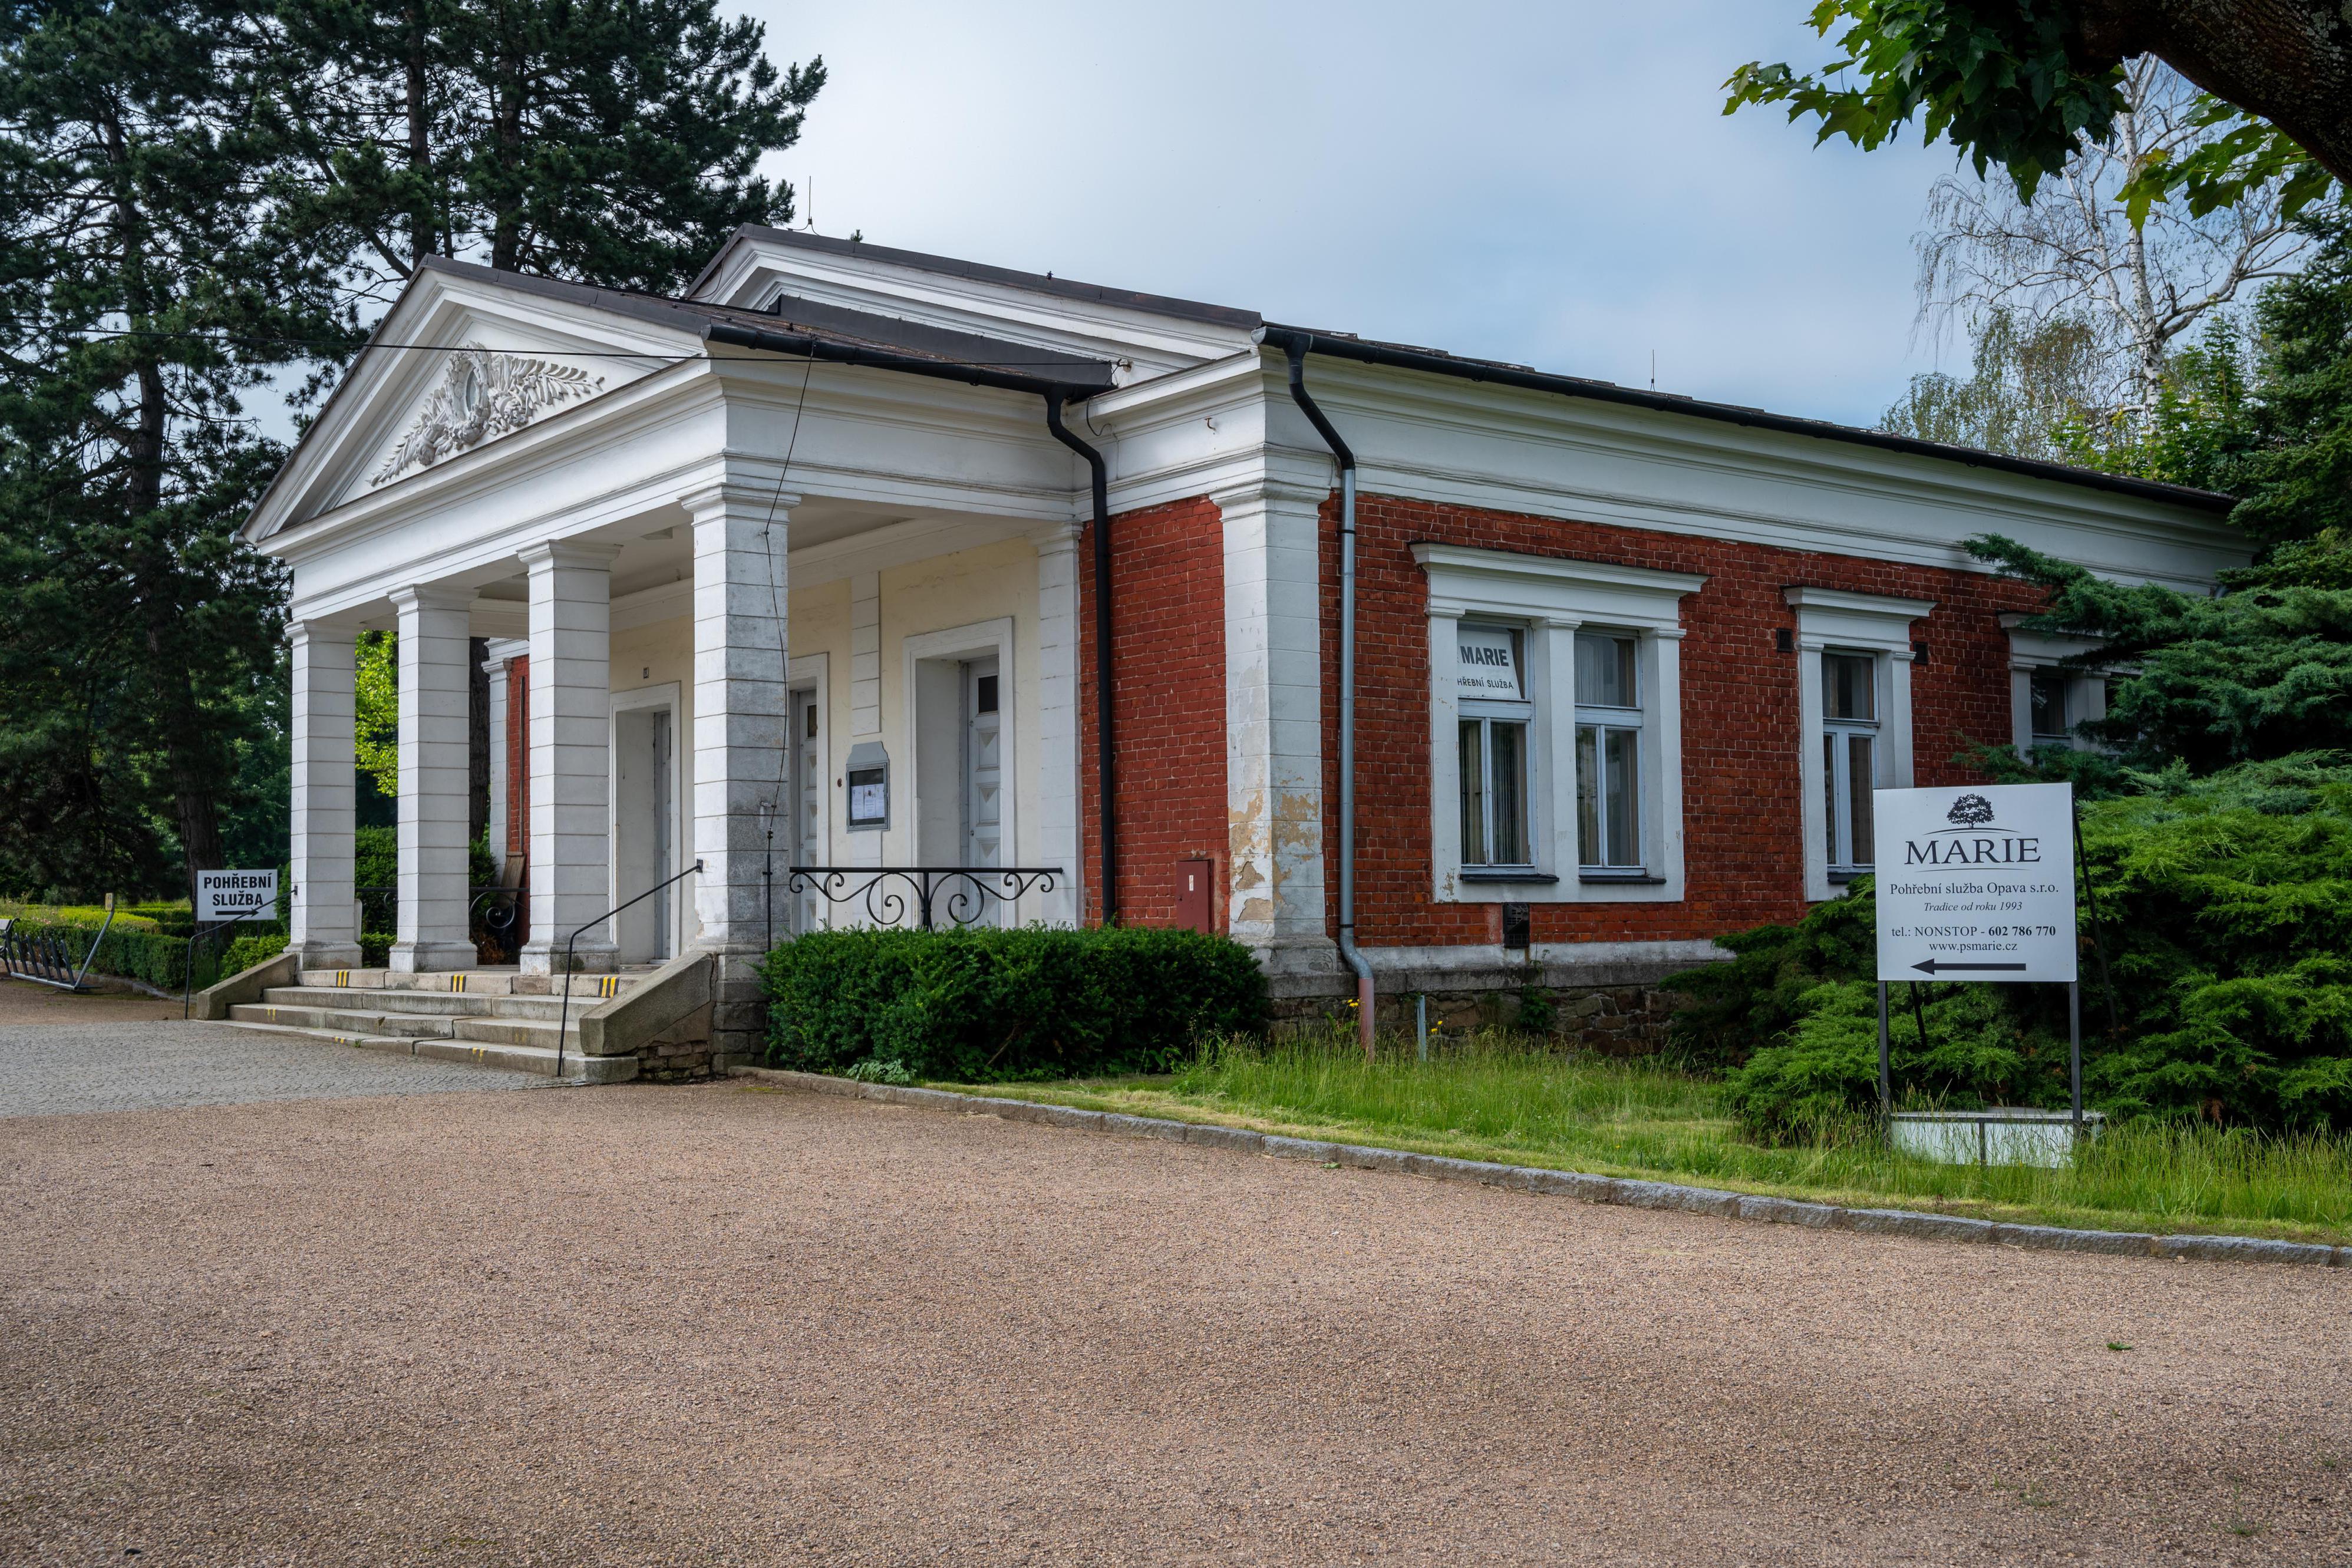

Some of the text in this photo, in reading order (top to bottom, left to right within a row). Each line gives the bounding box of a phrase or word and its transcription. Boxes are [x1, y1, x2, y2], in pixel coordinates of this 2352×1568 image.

[1460, 646, 1509, 666] MARIE
[1487, 679, 1514, 689] SLUŽBA
[1904, 838, 2041, 864] MARIE
[204, 873, 272, 889] POHŘEBNÍ
[1890, 882, 2059, 896] Pohřební služba Opava s.r.o.
[213, 890, 263, 906] SLUŽBA
[1924, 902, 2023, 912] Tradice od roku 1993
[1892, 926, 1911, 937] tel.:
[1915, 926, 1977, 937] NONSTOP
[1988, 926, 2008, 936] 602
[2012, 926, 2033, 936] 786
[2036, 926, 2056, 936] 770
[1929, 940, 2018, 953] www.psmarie.cz
